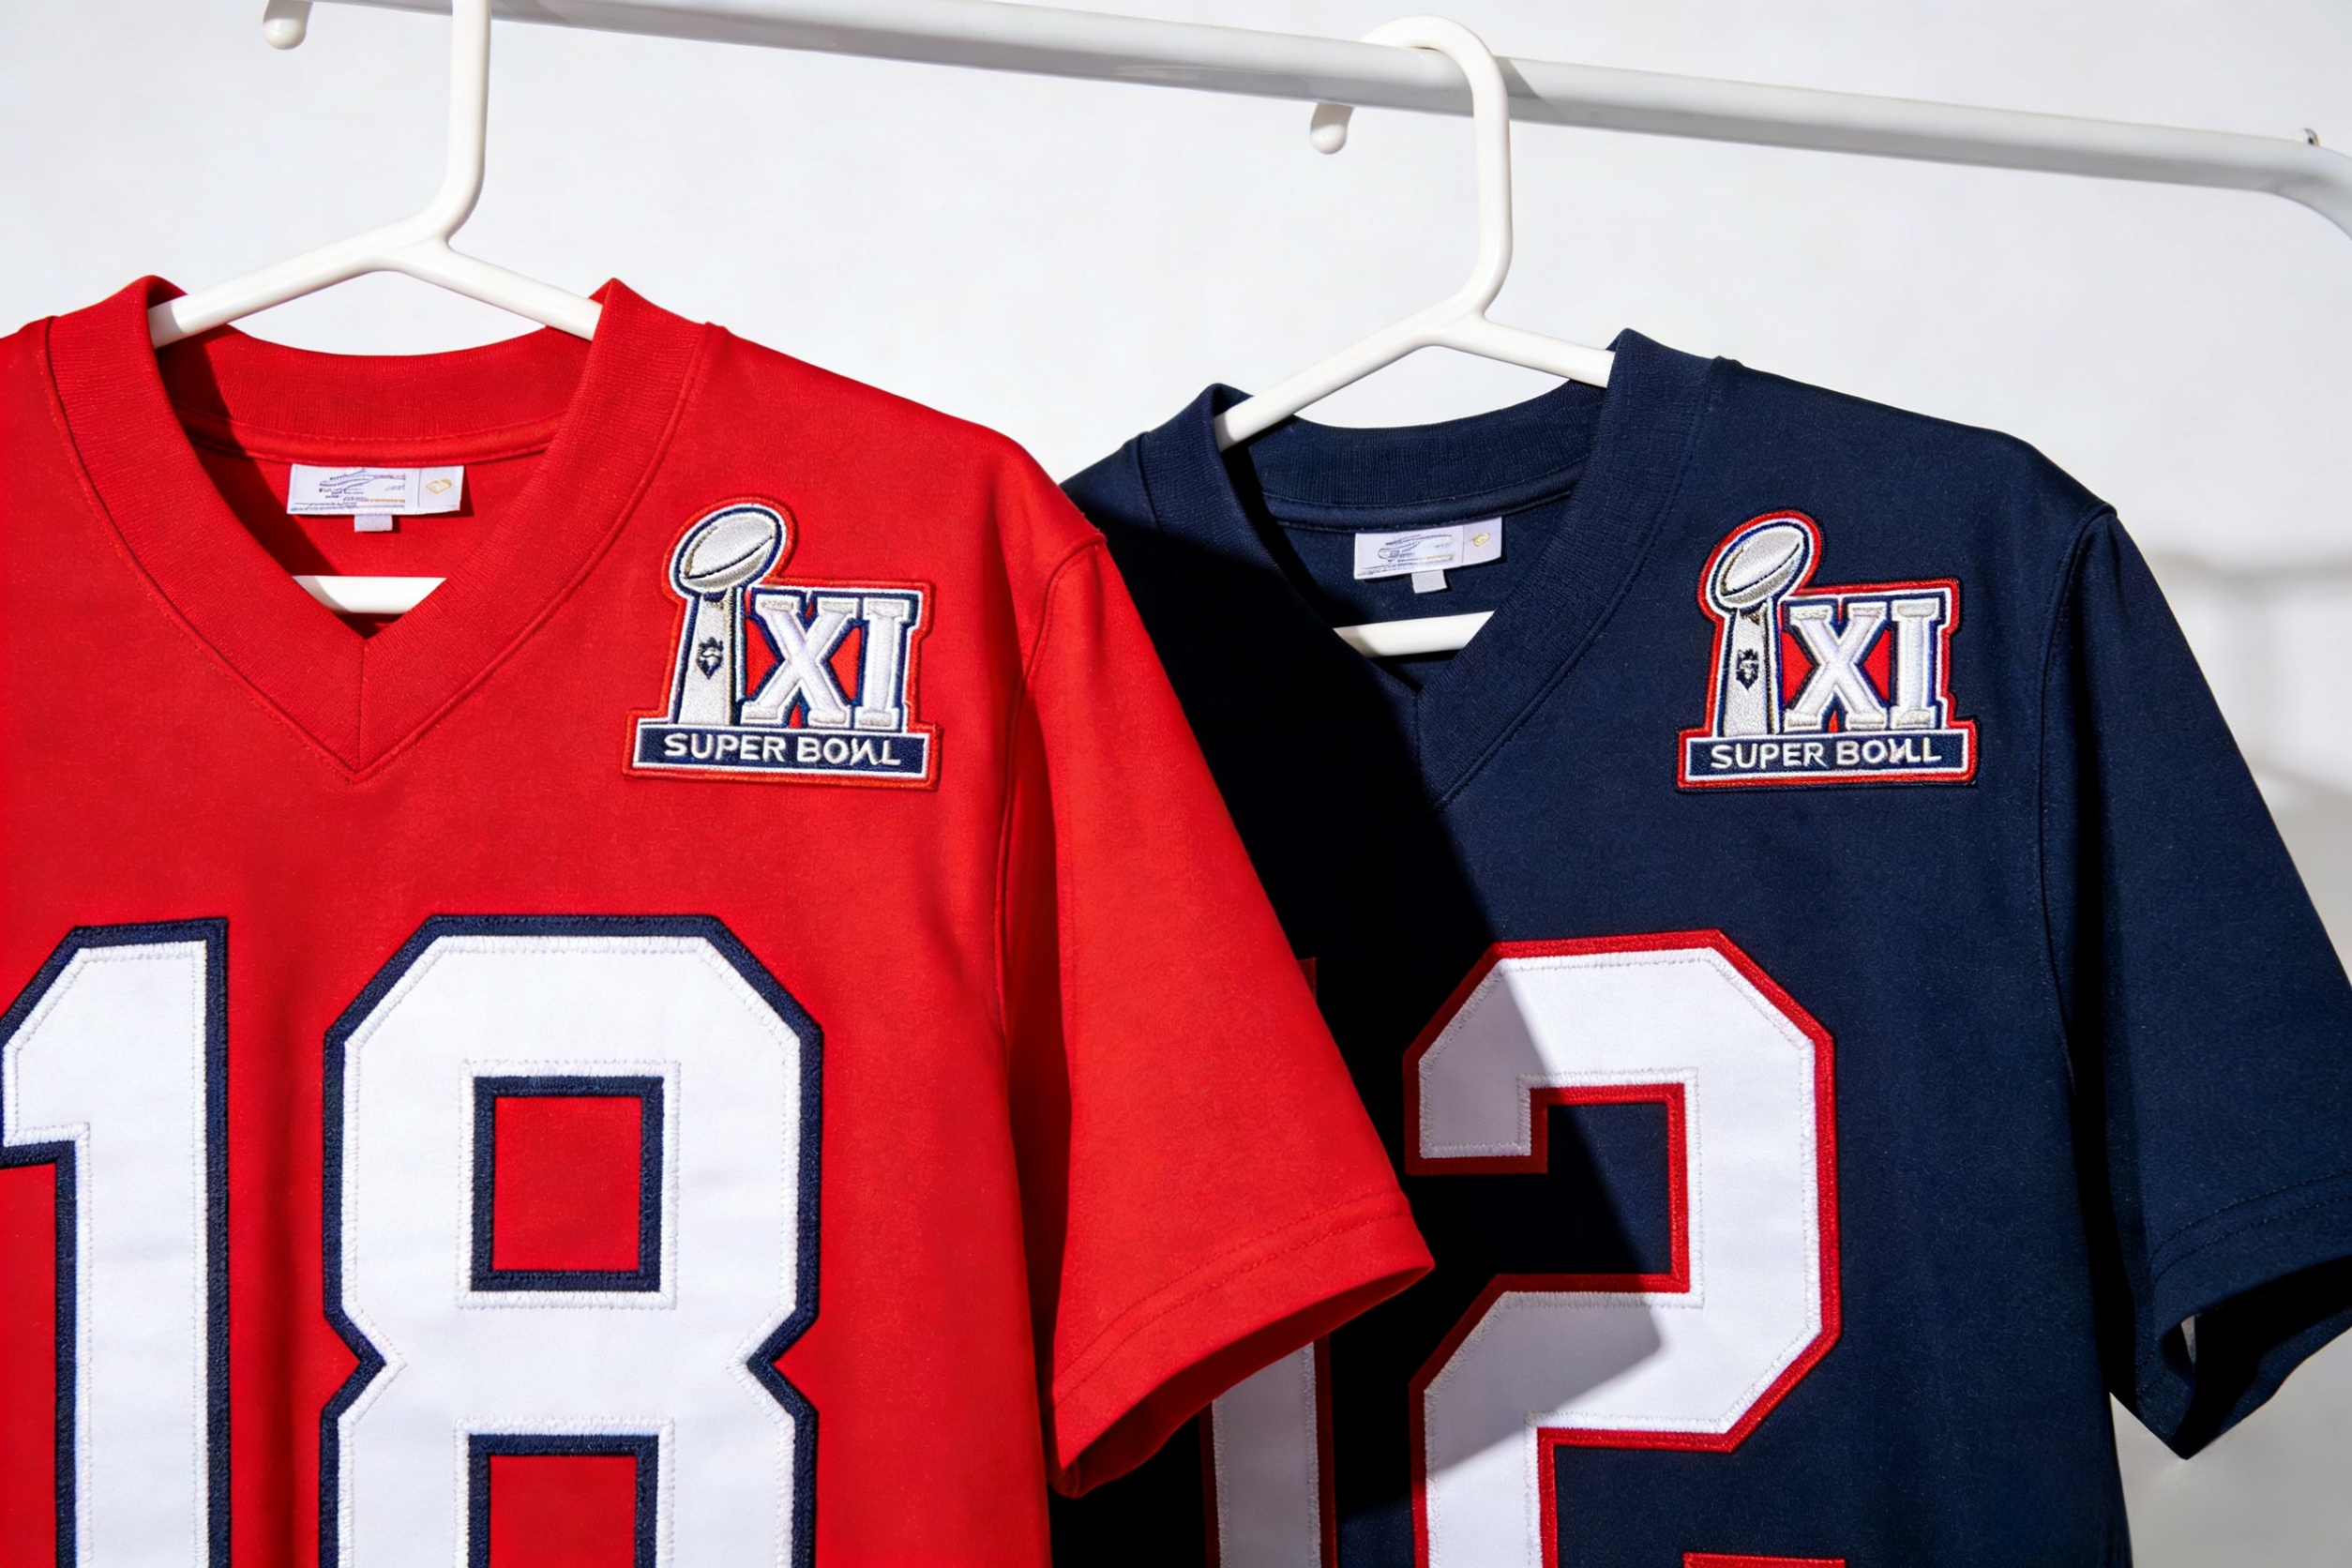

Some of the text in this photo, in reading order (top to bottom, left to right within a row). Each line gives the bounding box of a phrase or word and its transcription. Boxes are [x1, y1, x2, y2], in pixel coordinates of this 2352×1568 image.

[663, 732, 787, 763] SUPER
[1710, 741, 1830, 770] SUPER
[0, 915, 823, 1568] 18
